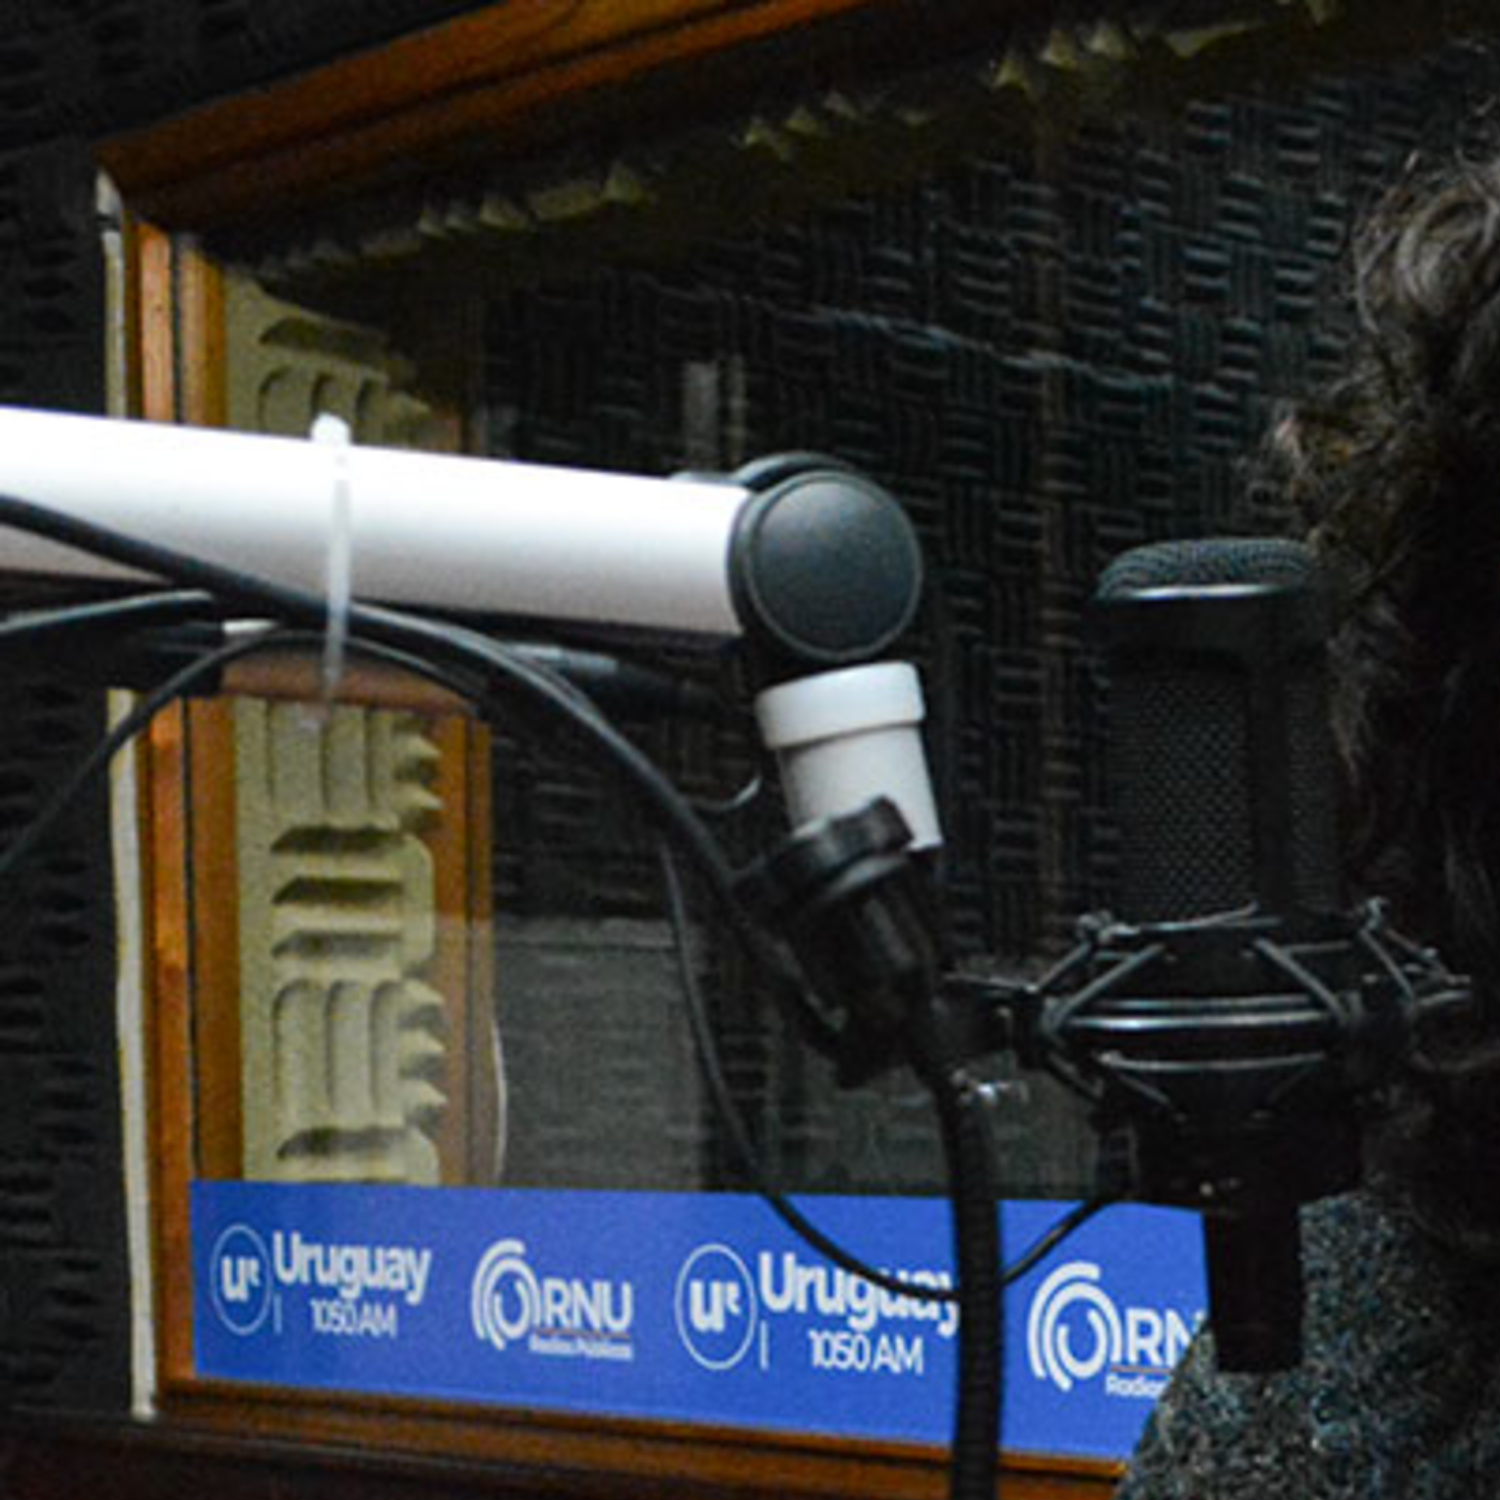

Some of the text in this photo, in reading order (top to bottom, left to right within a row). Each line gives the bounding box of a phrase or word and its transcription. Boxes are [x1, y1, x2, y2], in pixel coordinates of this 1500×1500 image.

[273, 1231, 432, 1305] Uruguay
[358, 1302, 398, 1338] AM
[543, 1276, 633, 1333] RNU
[808, 1329, 924, 1375] 1050 AM
[1126, 1308, 1206, 1367] RN
